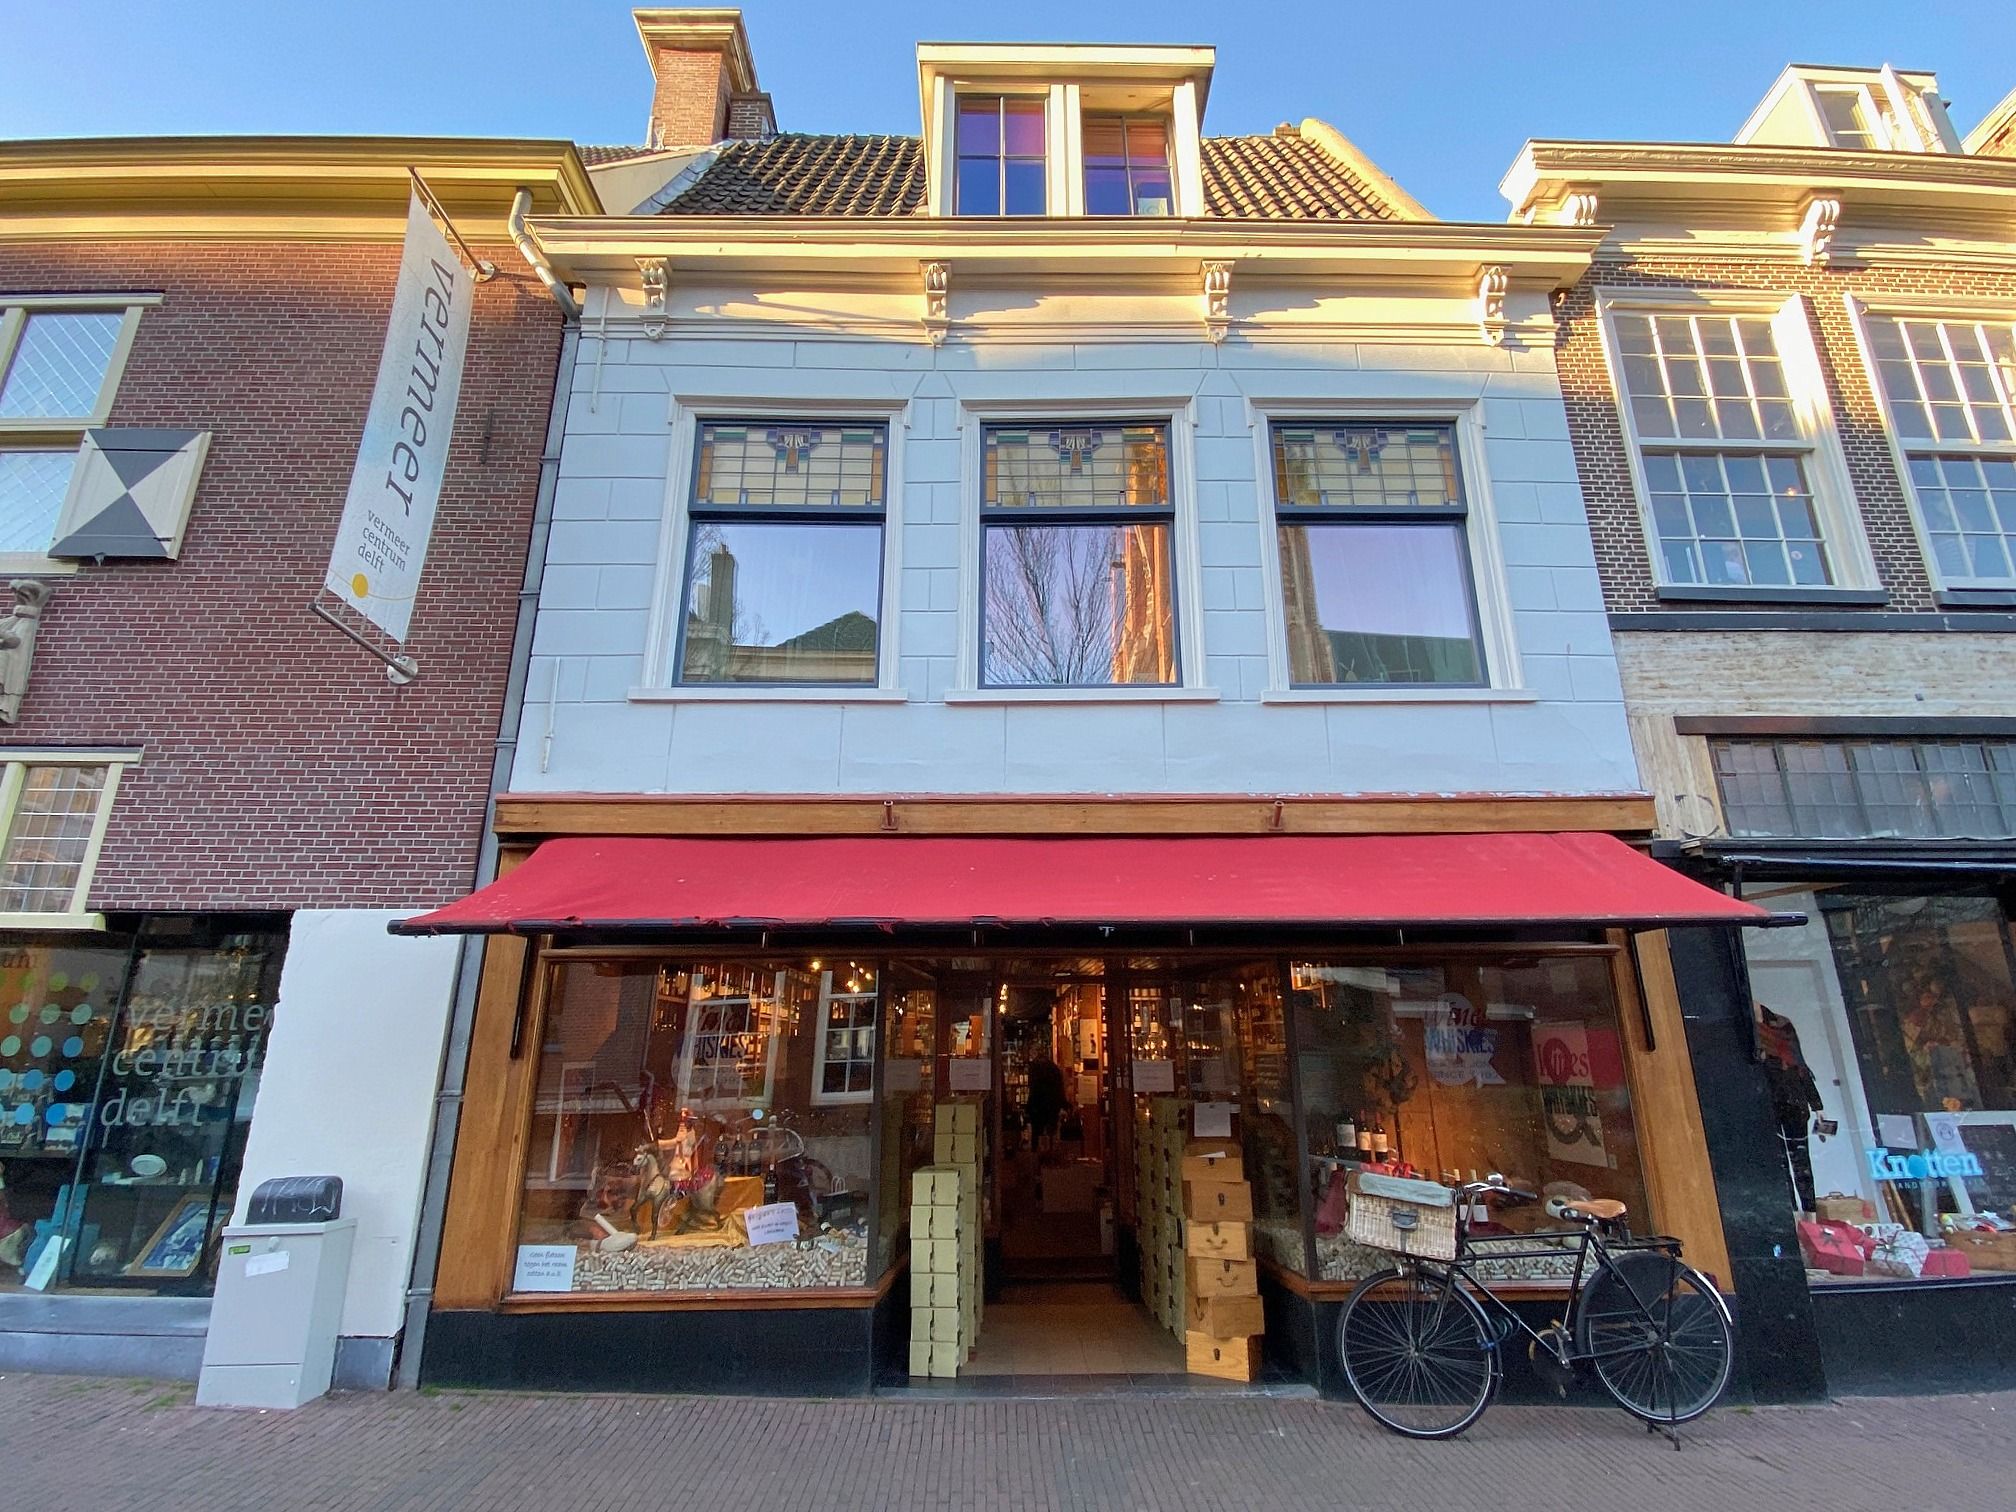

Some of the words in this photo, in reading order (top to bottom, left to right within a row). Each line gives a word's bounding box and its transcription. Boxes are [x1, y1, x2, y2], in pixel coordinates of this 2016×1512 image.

[385, 257, 454, 517] vermeer
[362, 527, 406, 572] centrum
[367, 509, 410, 556] vermeer
[358, 543, 384, 574] delft
[101, 1087, 206, 1128] delft
